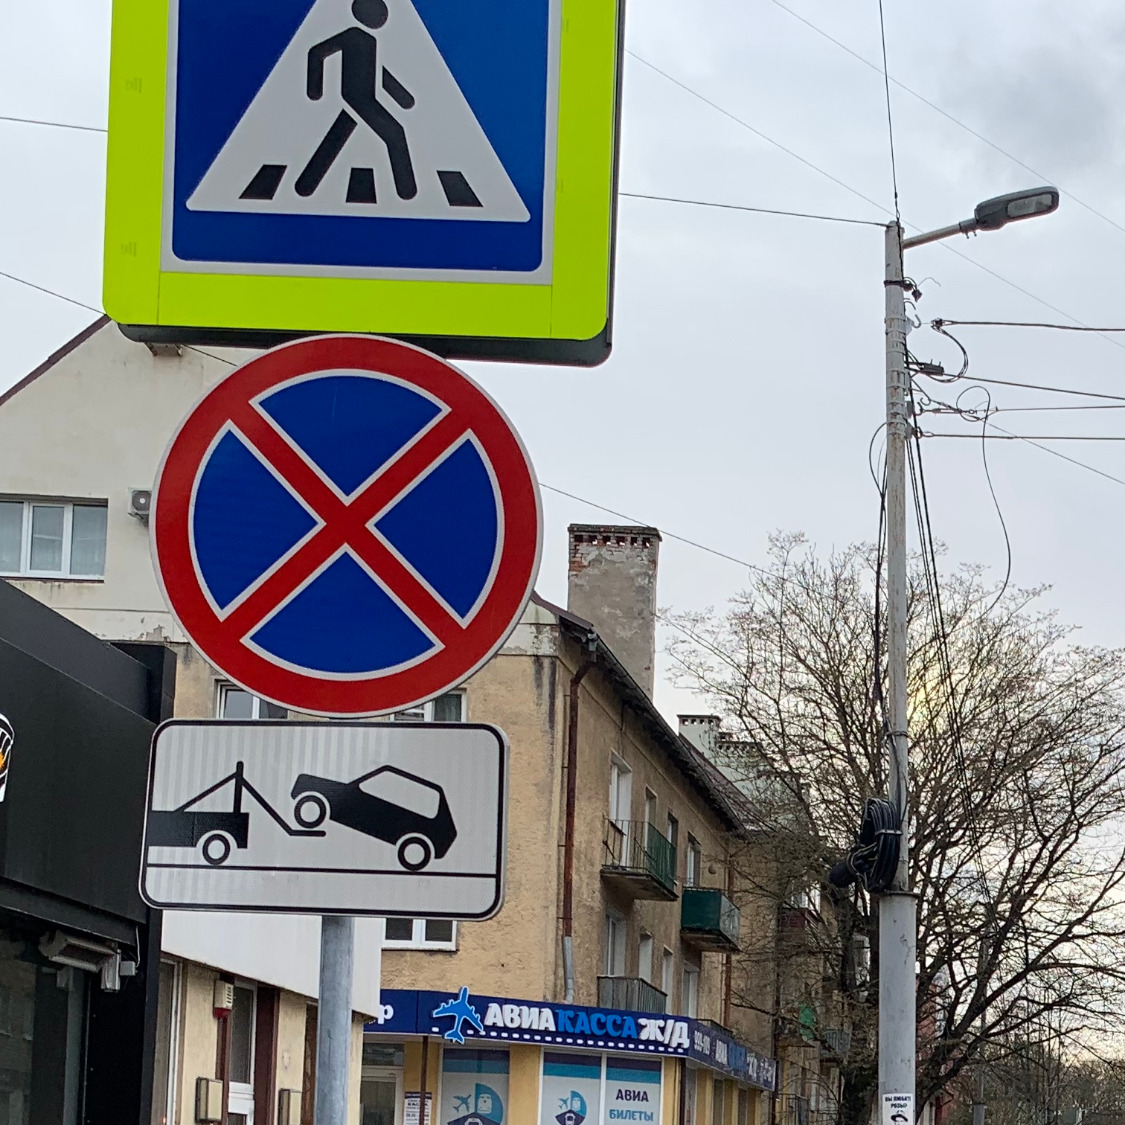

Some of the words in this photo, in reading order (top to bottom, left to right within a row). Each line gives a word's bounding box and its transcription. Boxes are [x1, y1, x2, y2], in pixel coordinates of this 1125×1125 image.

[484, 1003, 556, 1031] АВИА
[556, 1009, 637, 1039] КАССА
[638, 1018, 690, 1049] Ж/Д
[616, 1089, 649, 1102] АВИА
[609, 1109, 654, 1122] БИЛЕТЫ
